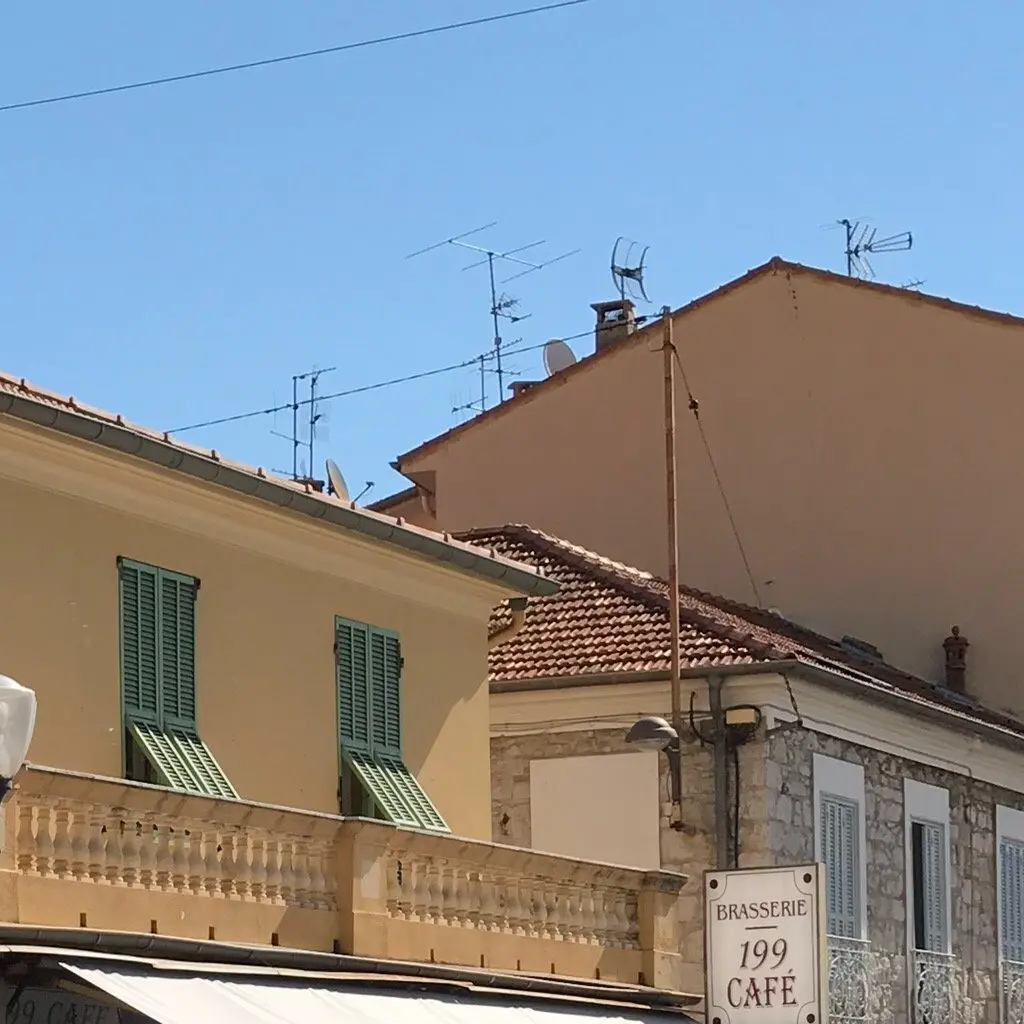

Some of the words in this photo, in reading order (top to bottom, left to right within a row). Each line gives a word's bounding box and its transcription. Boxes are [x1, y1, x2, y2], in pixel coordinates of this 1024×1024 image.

[717, 899, 808, 921] BRASSERIE
[740, 938, 787, 971] 199
[727, 968, 798, 1008] CAFÉ
